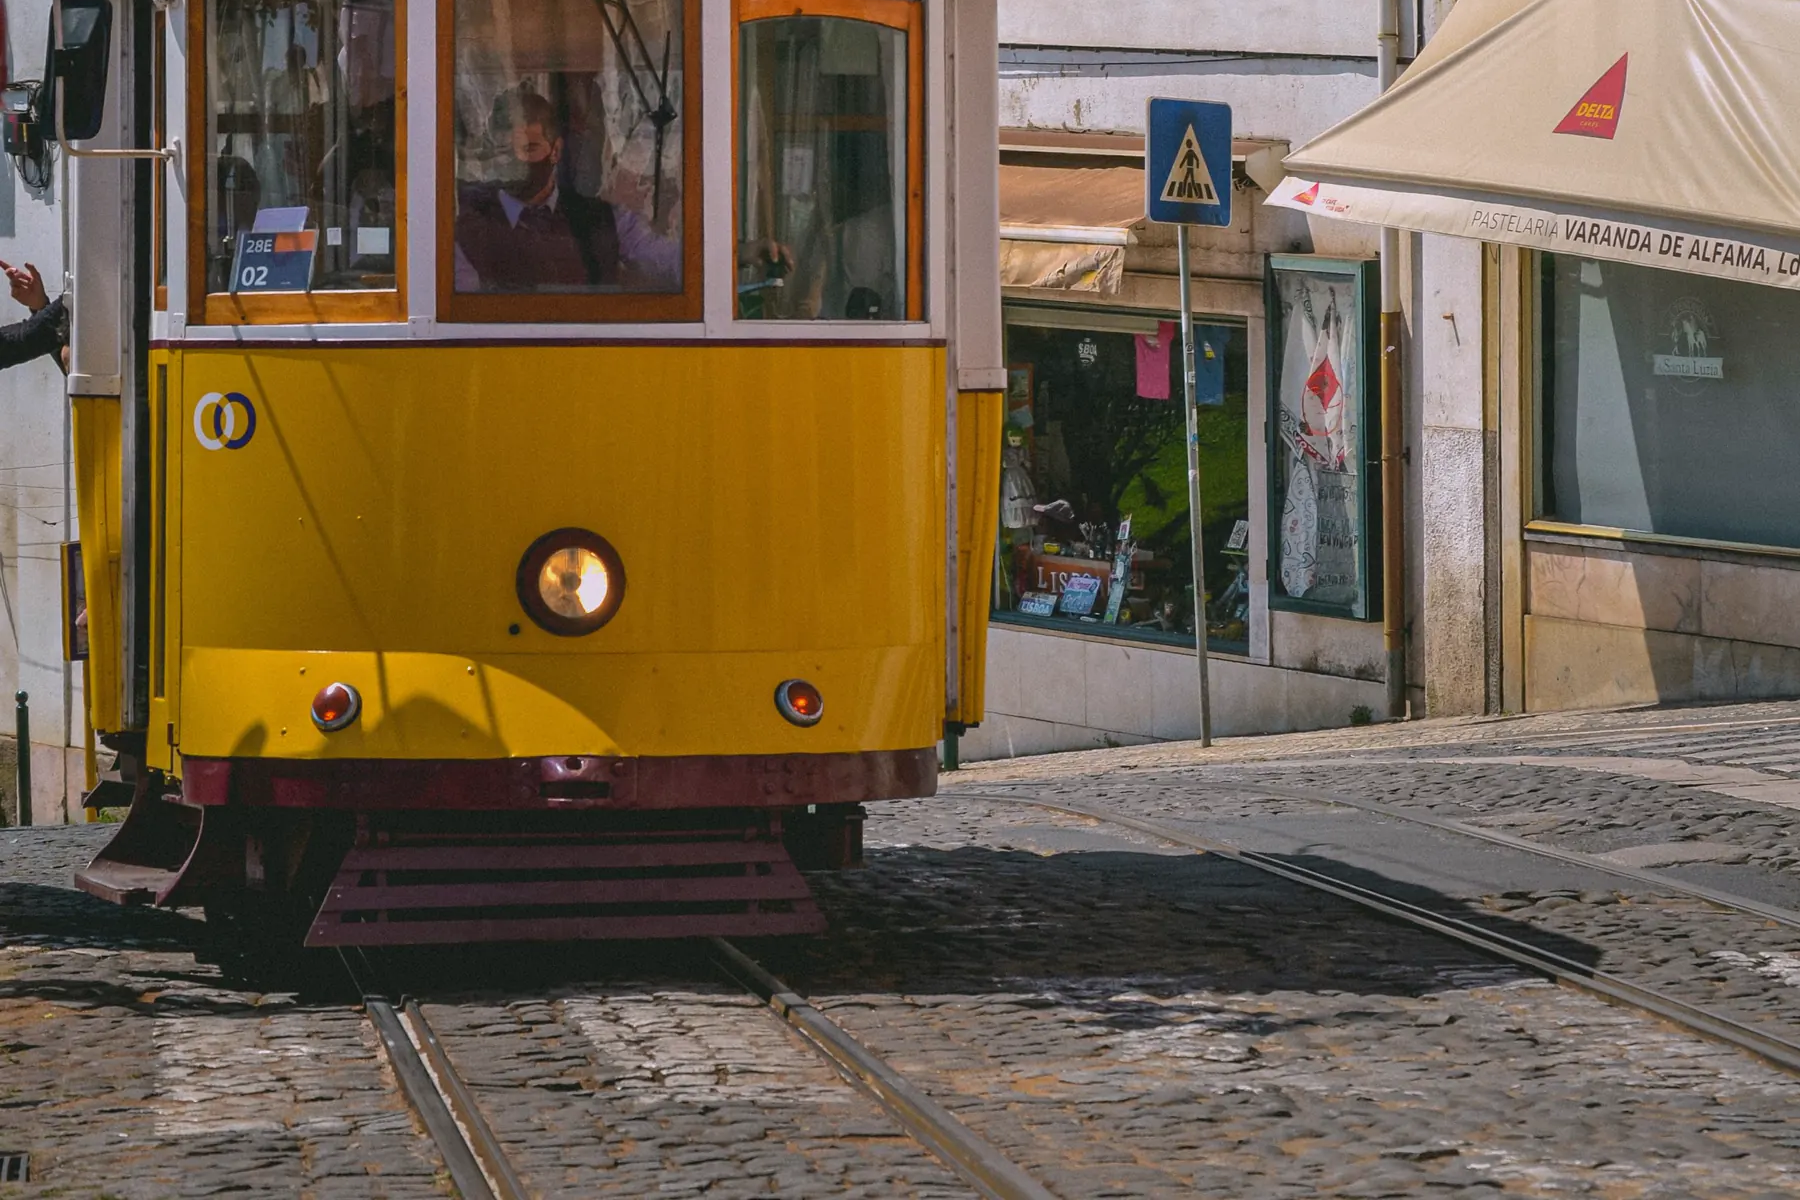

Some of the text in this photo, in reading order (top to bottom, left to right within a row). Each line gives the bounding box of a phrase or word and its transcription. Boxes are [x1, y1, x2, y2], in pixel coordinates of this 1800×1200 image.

[1575, 102, 1615, 120] DELTA
[246, 238, 273, 253] 28E
[1470, 210, 1559, 239] PASTELARIA
[1565, 218, 1651, 253] VARANDA
[1658, 233, 1685, 258] DE
[1688, 238, 1771, 275] ALFAMA,
[241, 265, 269, 287] 02
[1664, 357, 1719, 376] Santa Luzia
